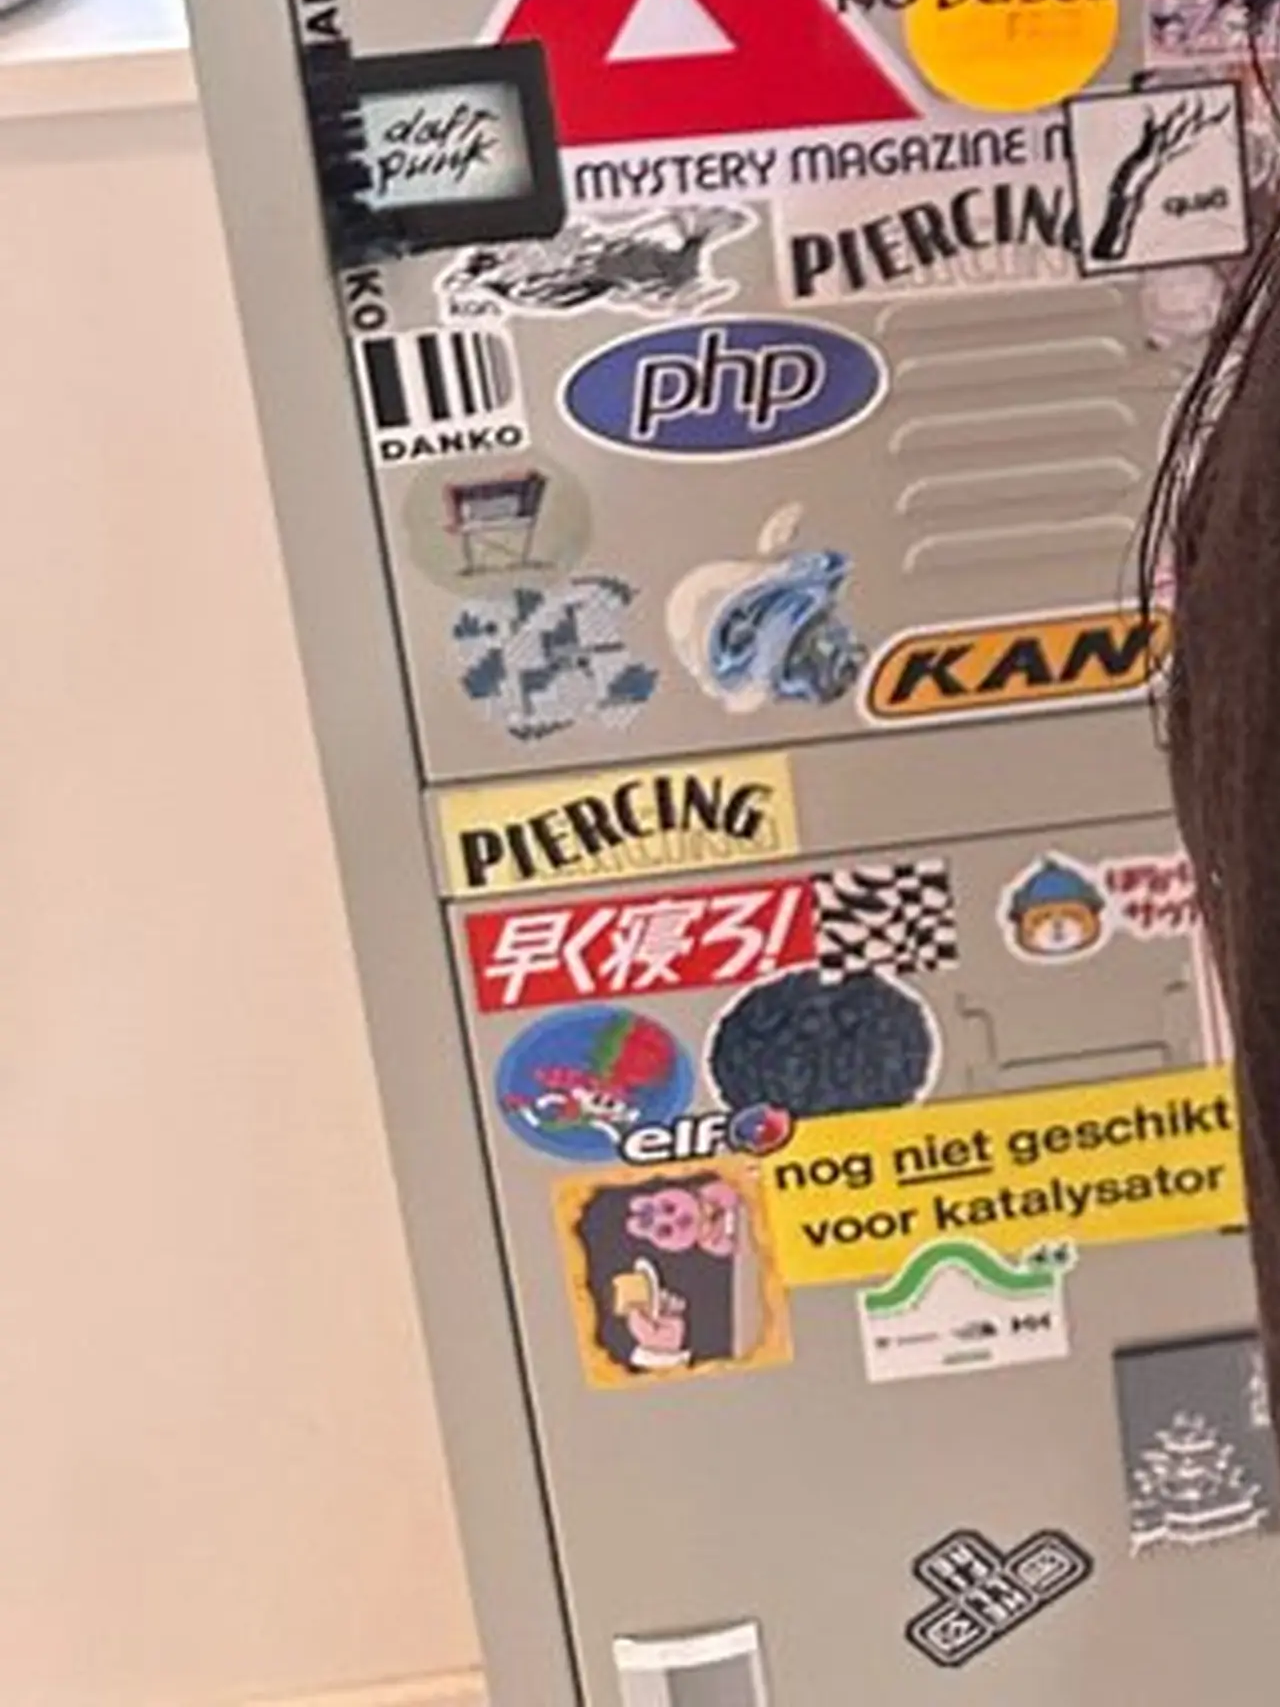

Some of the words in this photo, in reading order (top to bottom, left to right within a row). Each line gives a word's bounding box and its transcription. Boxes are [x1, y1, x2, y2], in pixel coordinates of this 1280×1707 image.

[375, 131, 499, 197] punk
[574, 151, 777, 200] MYSTERY
[791, 128, 1030, 183] MAGAZINE
[633, 329, 823, 439] php
[380, 425, 522, 462] DANKO
[460, 775, 776, 888] PIERCING
[622, 1117, 727, 1161] elf
[774, 1151, 875, 1190] nog
[894, 1129, 994, 1176] niet
[1007, 1096, 1234, 1165] geschikt
[803, 1208, 920, 1247] voor
[933, 1165, 1226, 1232] katalysator
